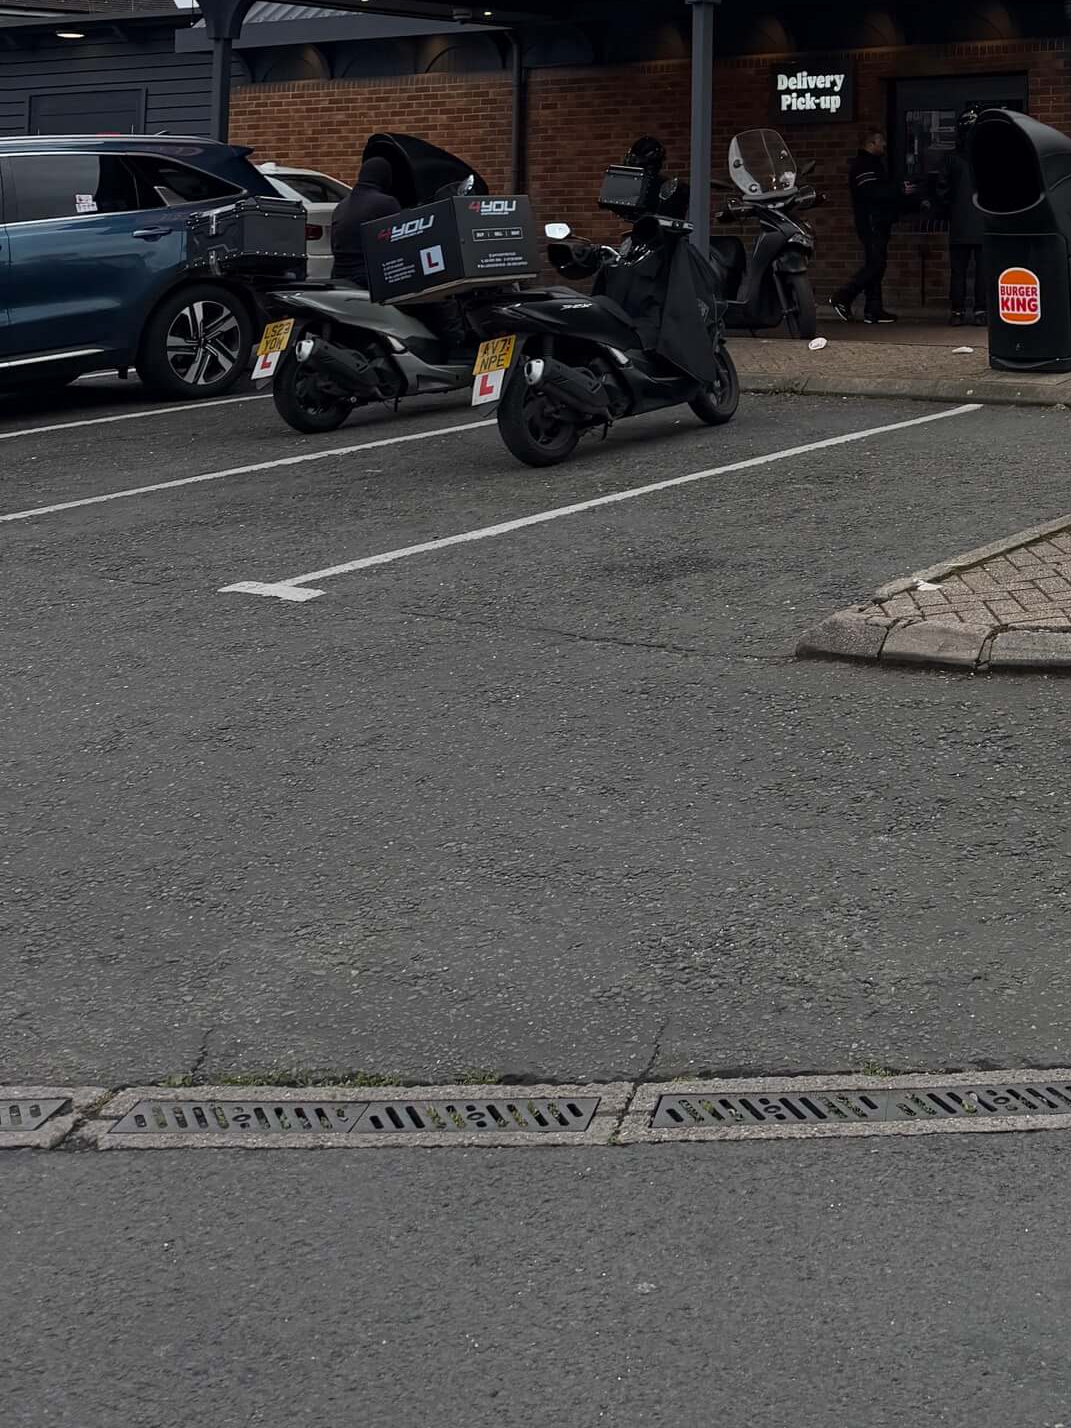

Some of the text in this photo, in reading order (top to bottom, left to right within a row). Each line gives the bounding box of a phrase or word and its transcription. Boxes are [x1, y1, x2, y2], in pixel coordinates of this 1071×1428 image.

[777, 71, 845, 92] Delivery
[781, 92, 841, 113] Pick-up
[468, 200, 516, 213] 4YOU
[377, 214, 435, 241] 4YOU
[426, 252, 439, 269] L
[1000, 285, 1038, 297] BURGER
[1000, 296, 1039, 313] KING
[261, 354, 272, 370] L
[479, 353, 505, 372] NPE
[479, 374, 494, 397] L
